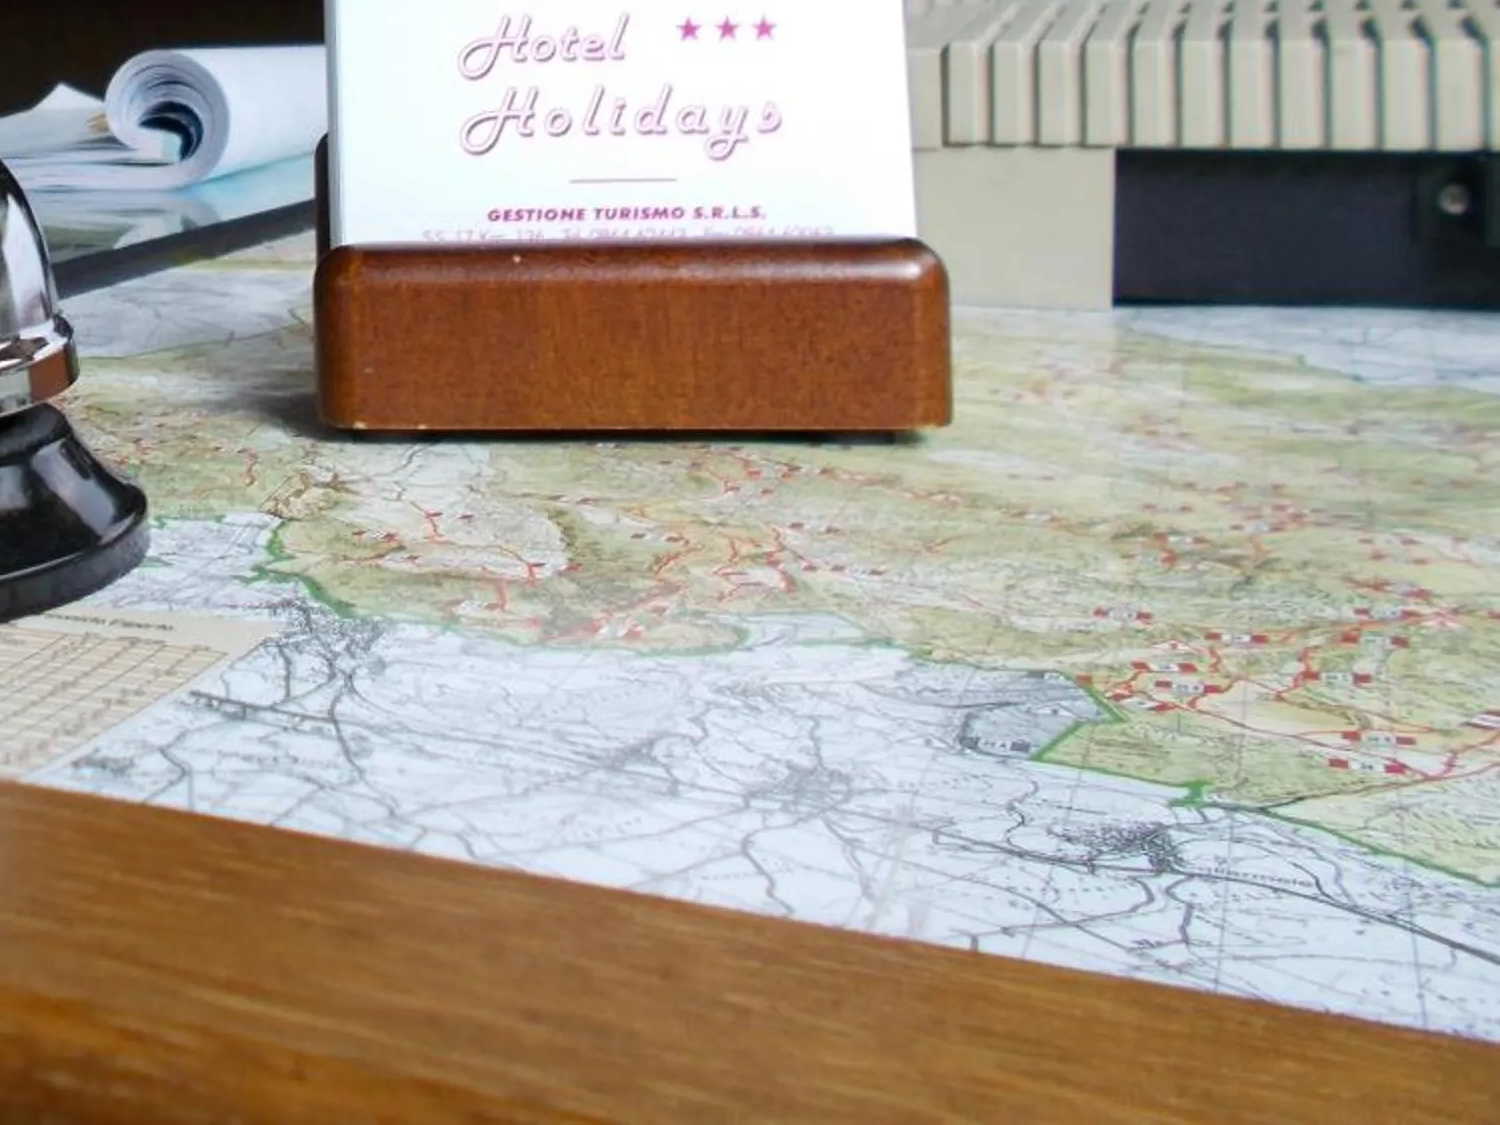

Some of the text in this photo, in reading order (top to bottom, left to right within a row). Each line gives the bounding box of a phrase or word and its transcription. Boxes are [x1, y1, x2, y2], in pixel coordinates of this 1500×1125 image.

[457, 12, 630, 81] Hotel
[460, 83, 782, 162] Holidays
[487, 204, 767, 222] GESTIONE TURISMO S.R.L.S.
